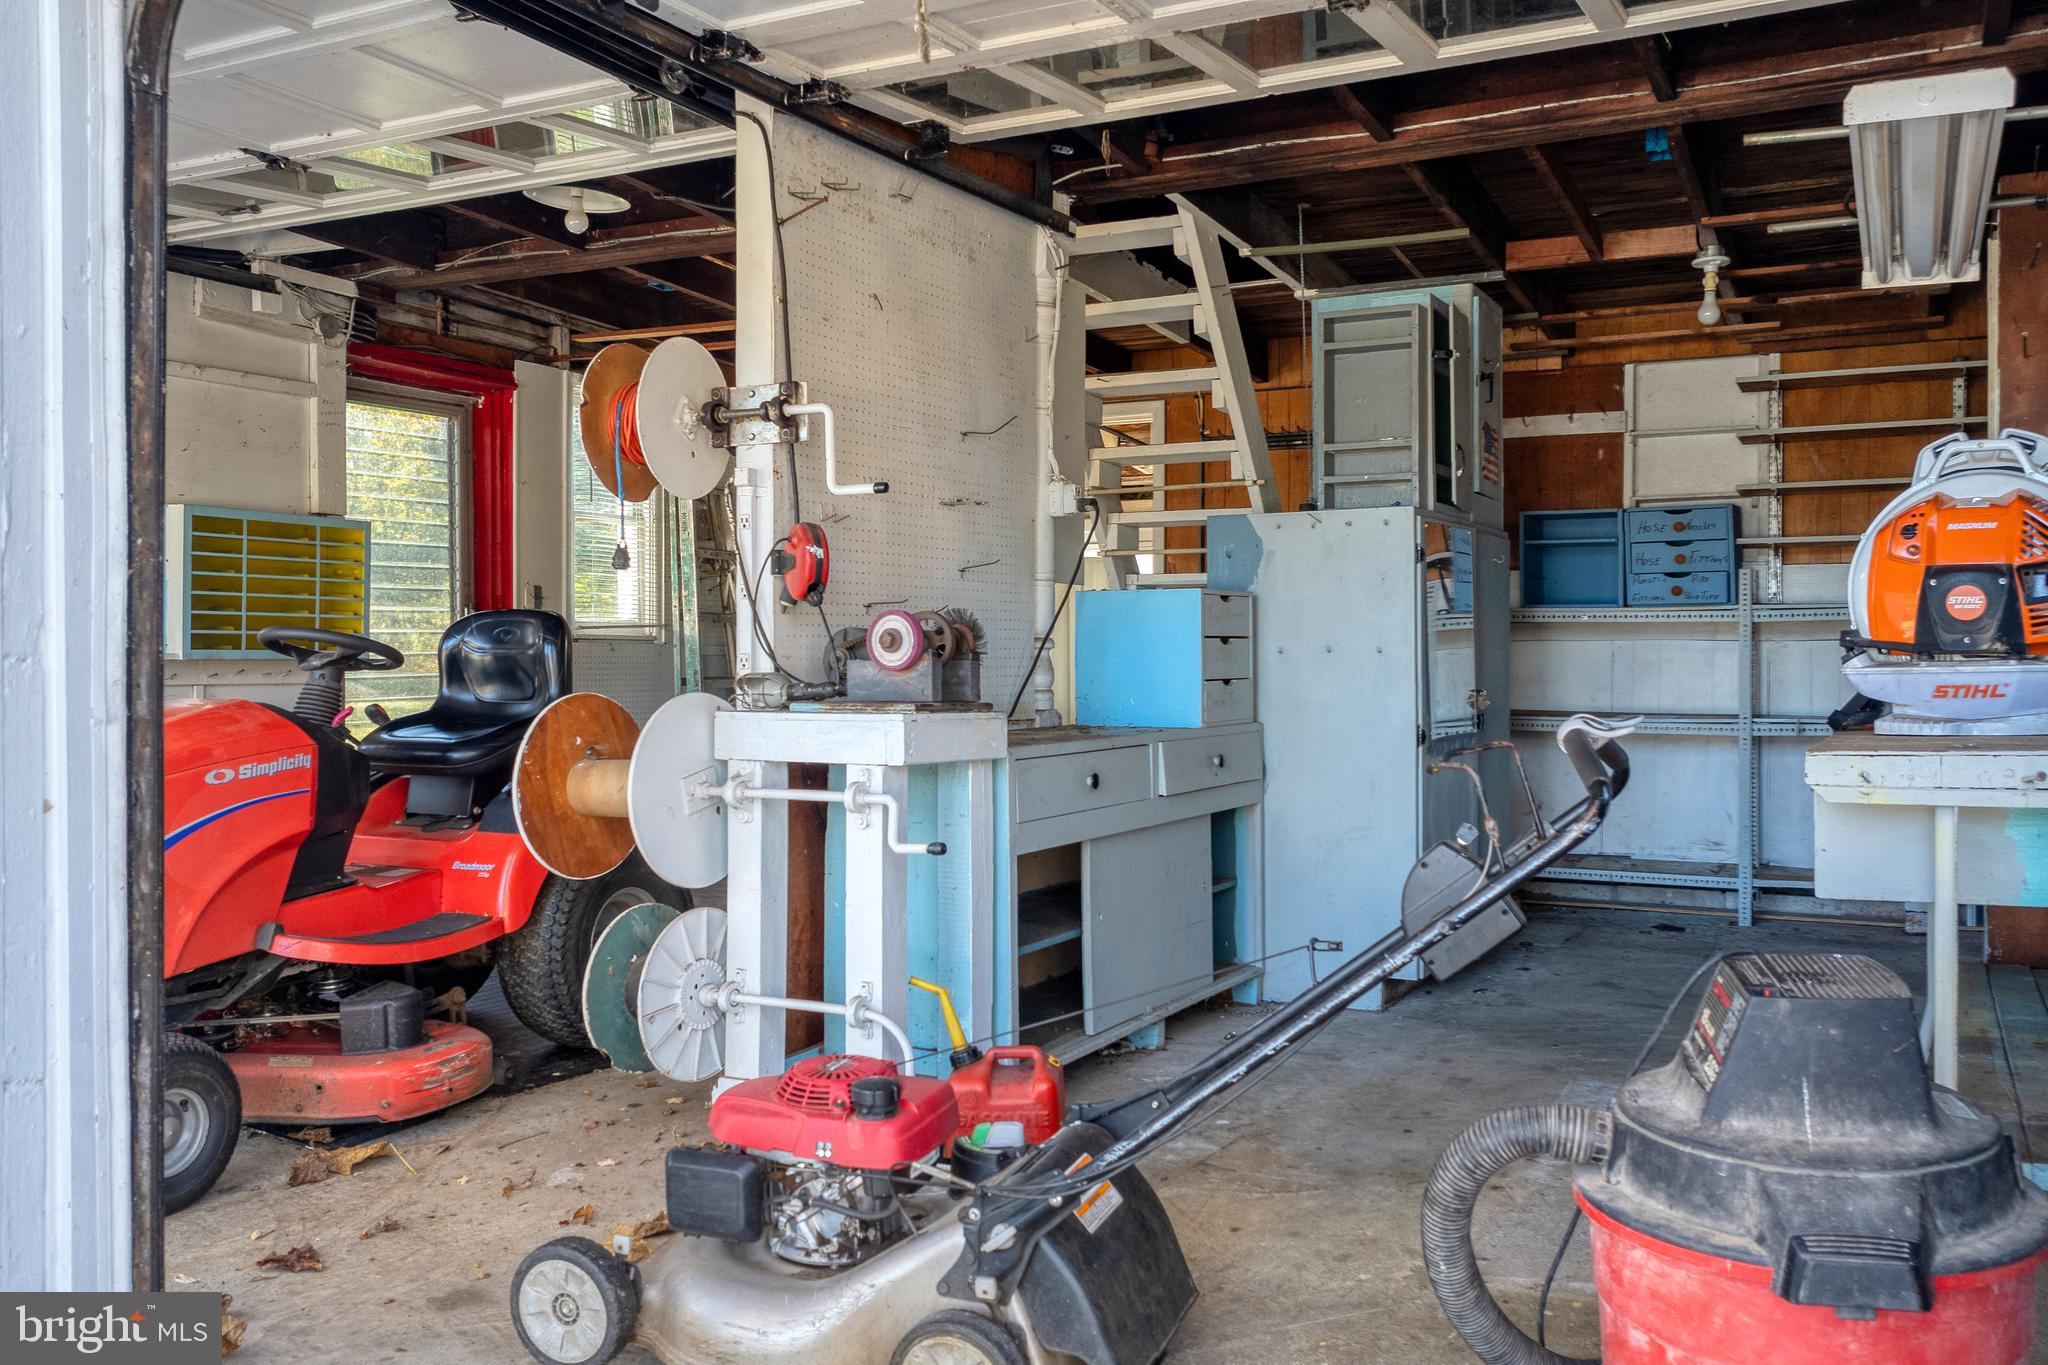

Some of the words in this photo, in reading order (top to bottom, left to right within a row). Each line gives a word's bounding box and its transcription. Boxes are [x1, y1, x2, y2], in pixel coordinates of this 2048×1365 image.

[1638, 520, 1669, 534] HOSE
[1635, 551, 1662, 567] HOSE
[1947, 595, 1984, 604] STIHL
[1932, 684, 2006, 699] STIHL
[238, 753, 312, 780] Simplicity
[451, 861, 496, 871] Broadmoor
